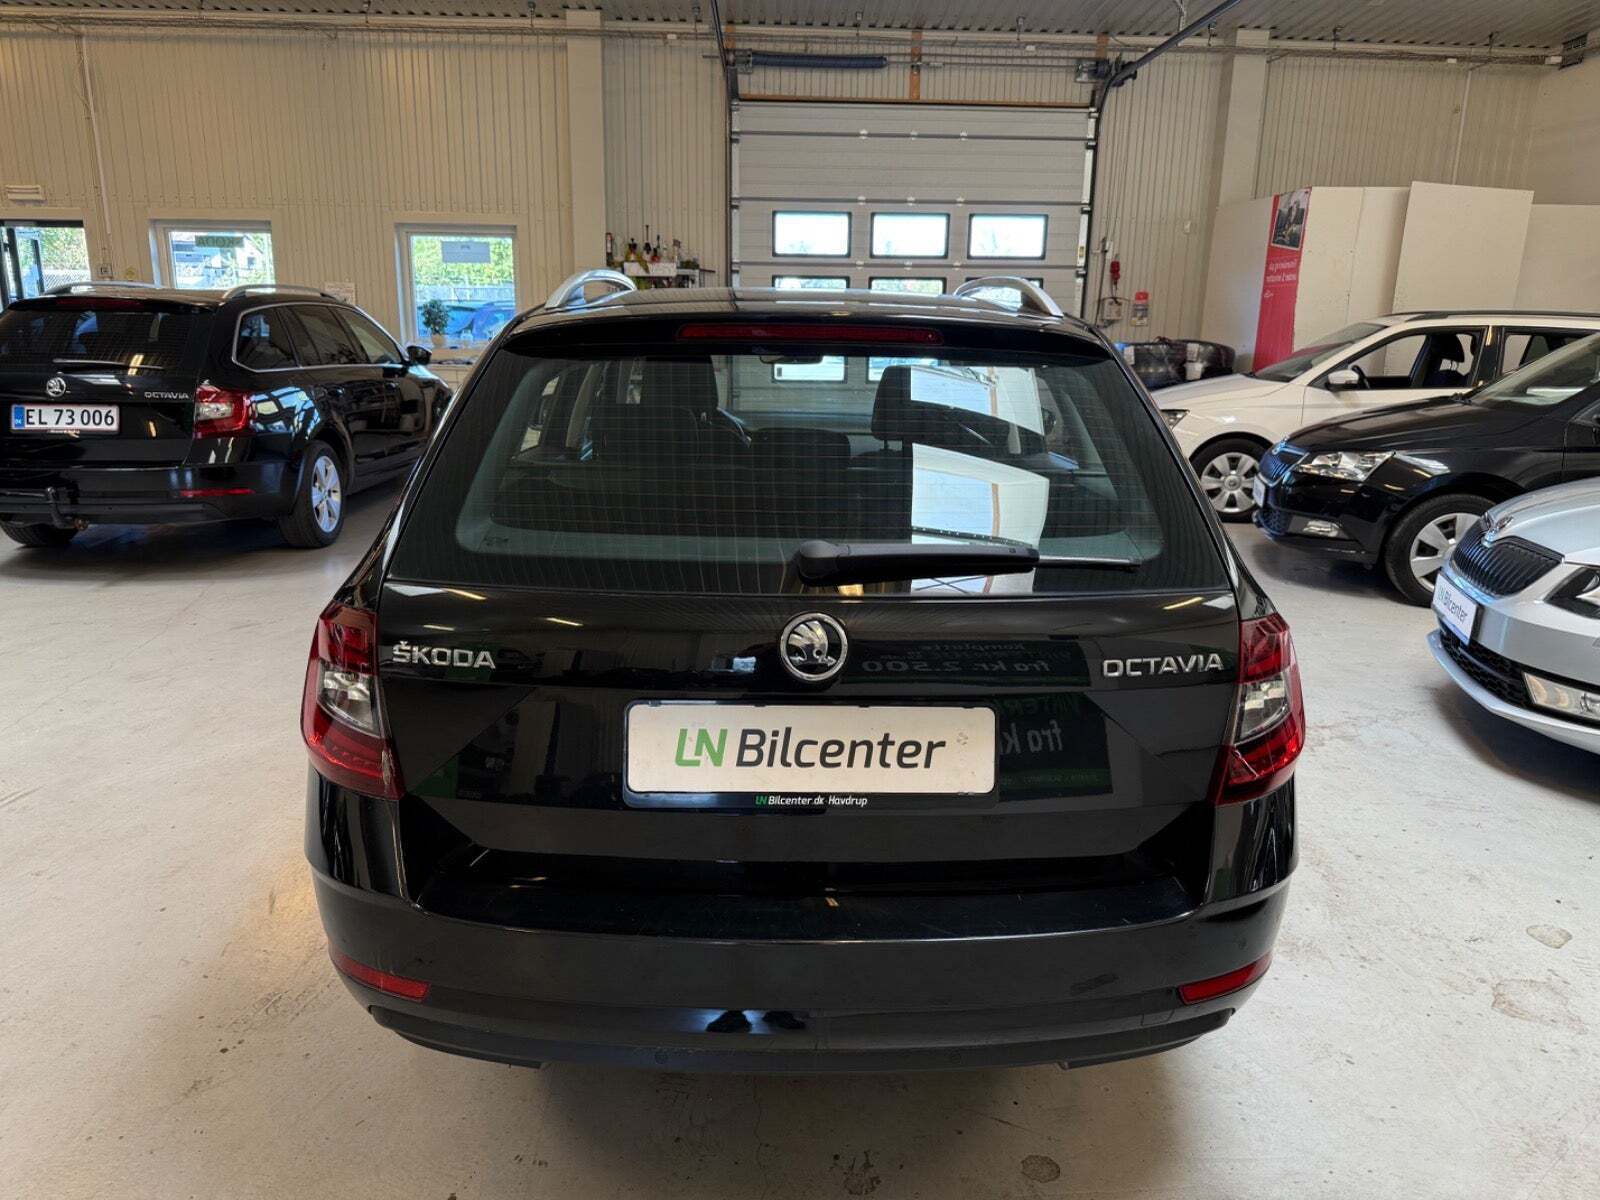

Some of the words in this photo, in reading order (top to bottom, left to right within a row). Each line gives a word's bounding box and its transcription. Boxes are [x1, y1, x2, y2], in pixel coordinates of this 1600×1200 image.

[144, 391, 190, 400] OCTAVIA
[26, 408, 48, 425] EL
[54, 409, 75, 426] 73
[80, 409, 115, 426] 006
[392, 640, 497, 669] ŠKODA
[1103, 653, 1225, 677] OCTAVIA
[674, 728, 728, 767] LN
[735, 726, 946, 769] Bilcenter
[828, 795, 868, 808] Havdrup
